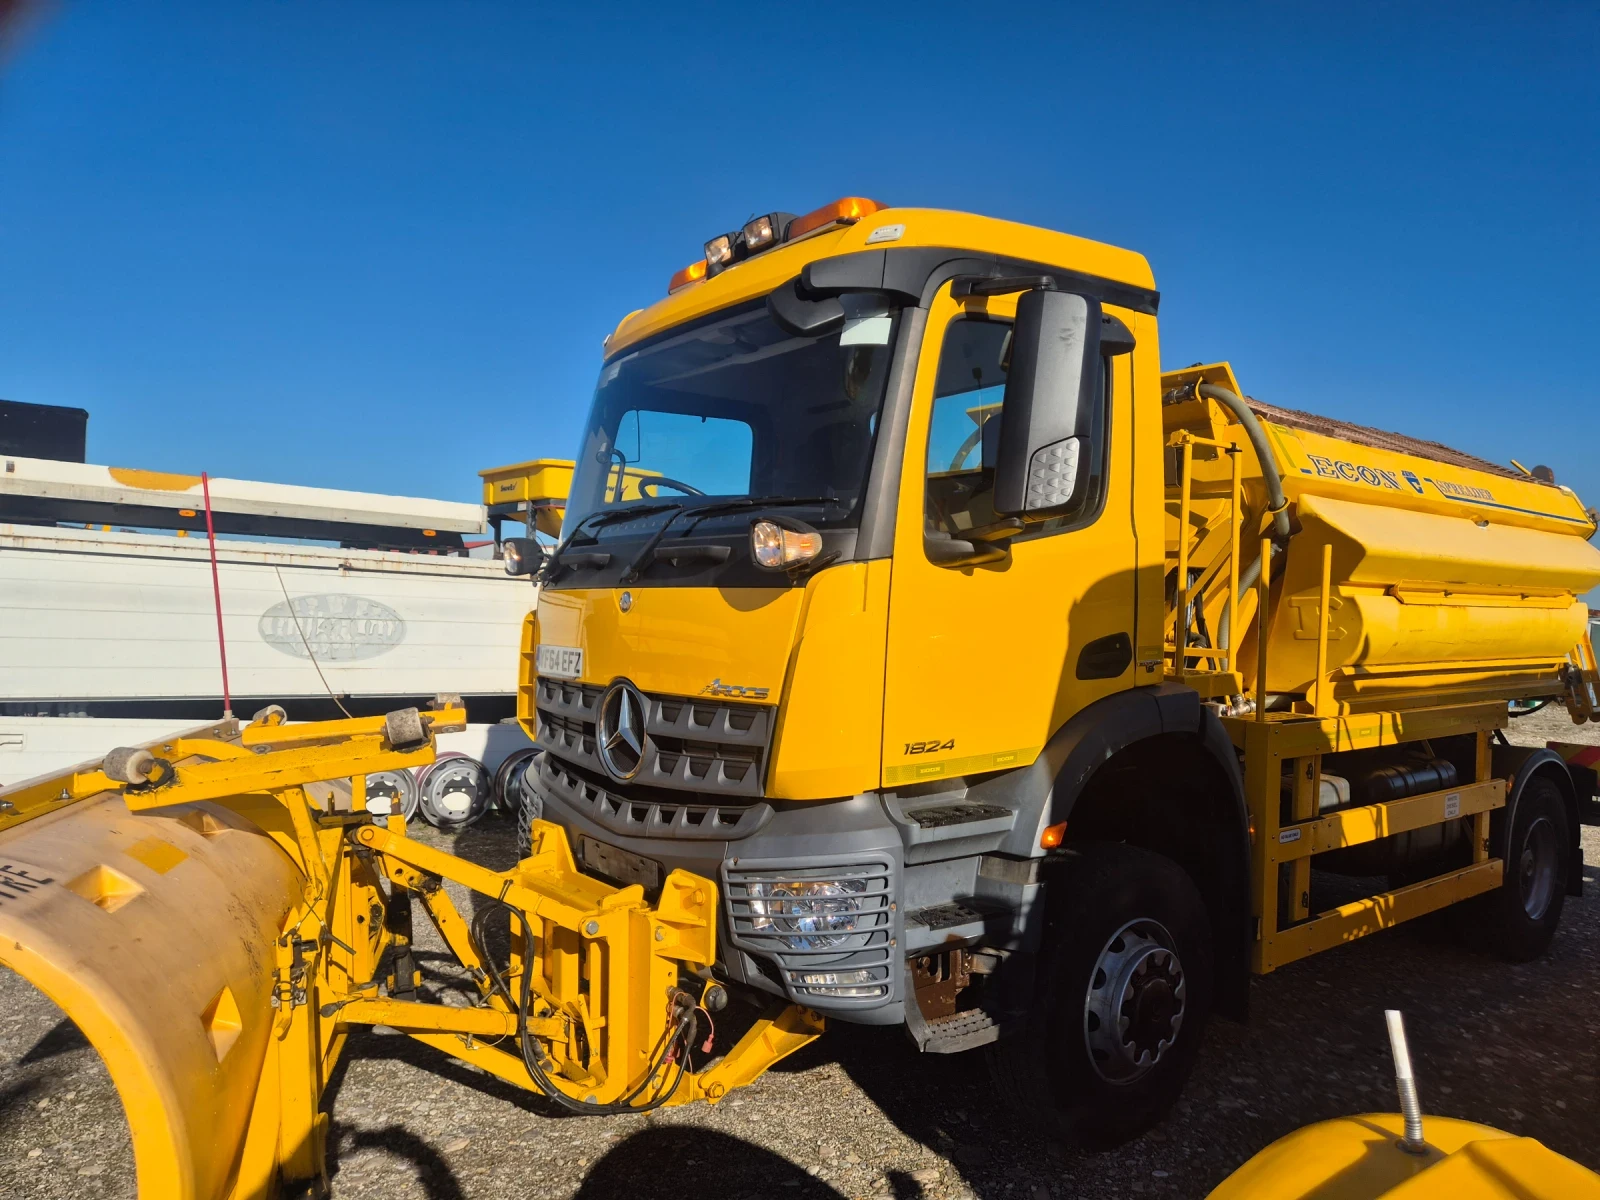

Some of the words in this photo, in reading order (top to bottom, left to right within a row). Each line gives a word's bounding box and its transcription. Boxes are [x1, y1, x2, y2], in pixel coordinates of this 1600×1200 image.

[1306, 453, 1404, 491] ECON
[1435, 479, 1496, 501] SPREADER
[561, 650, 582, 674] EFZ
[904, 738, 956, 756] 1824
